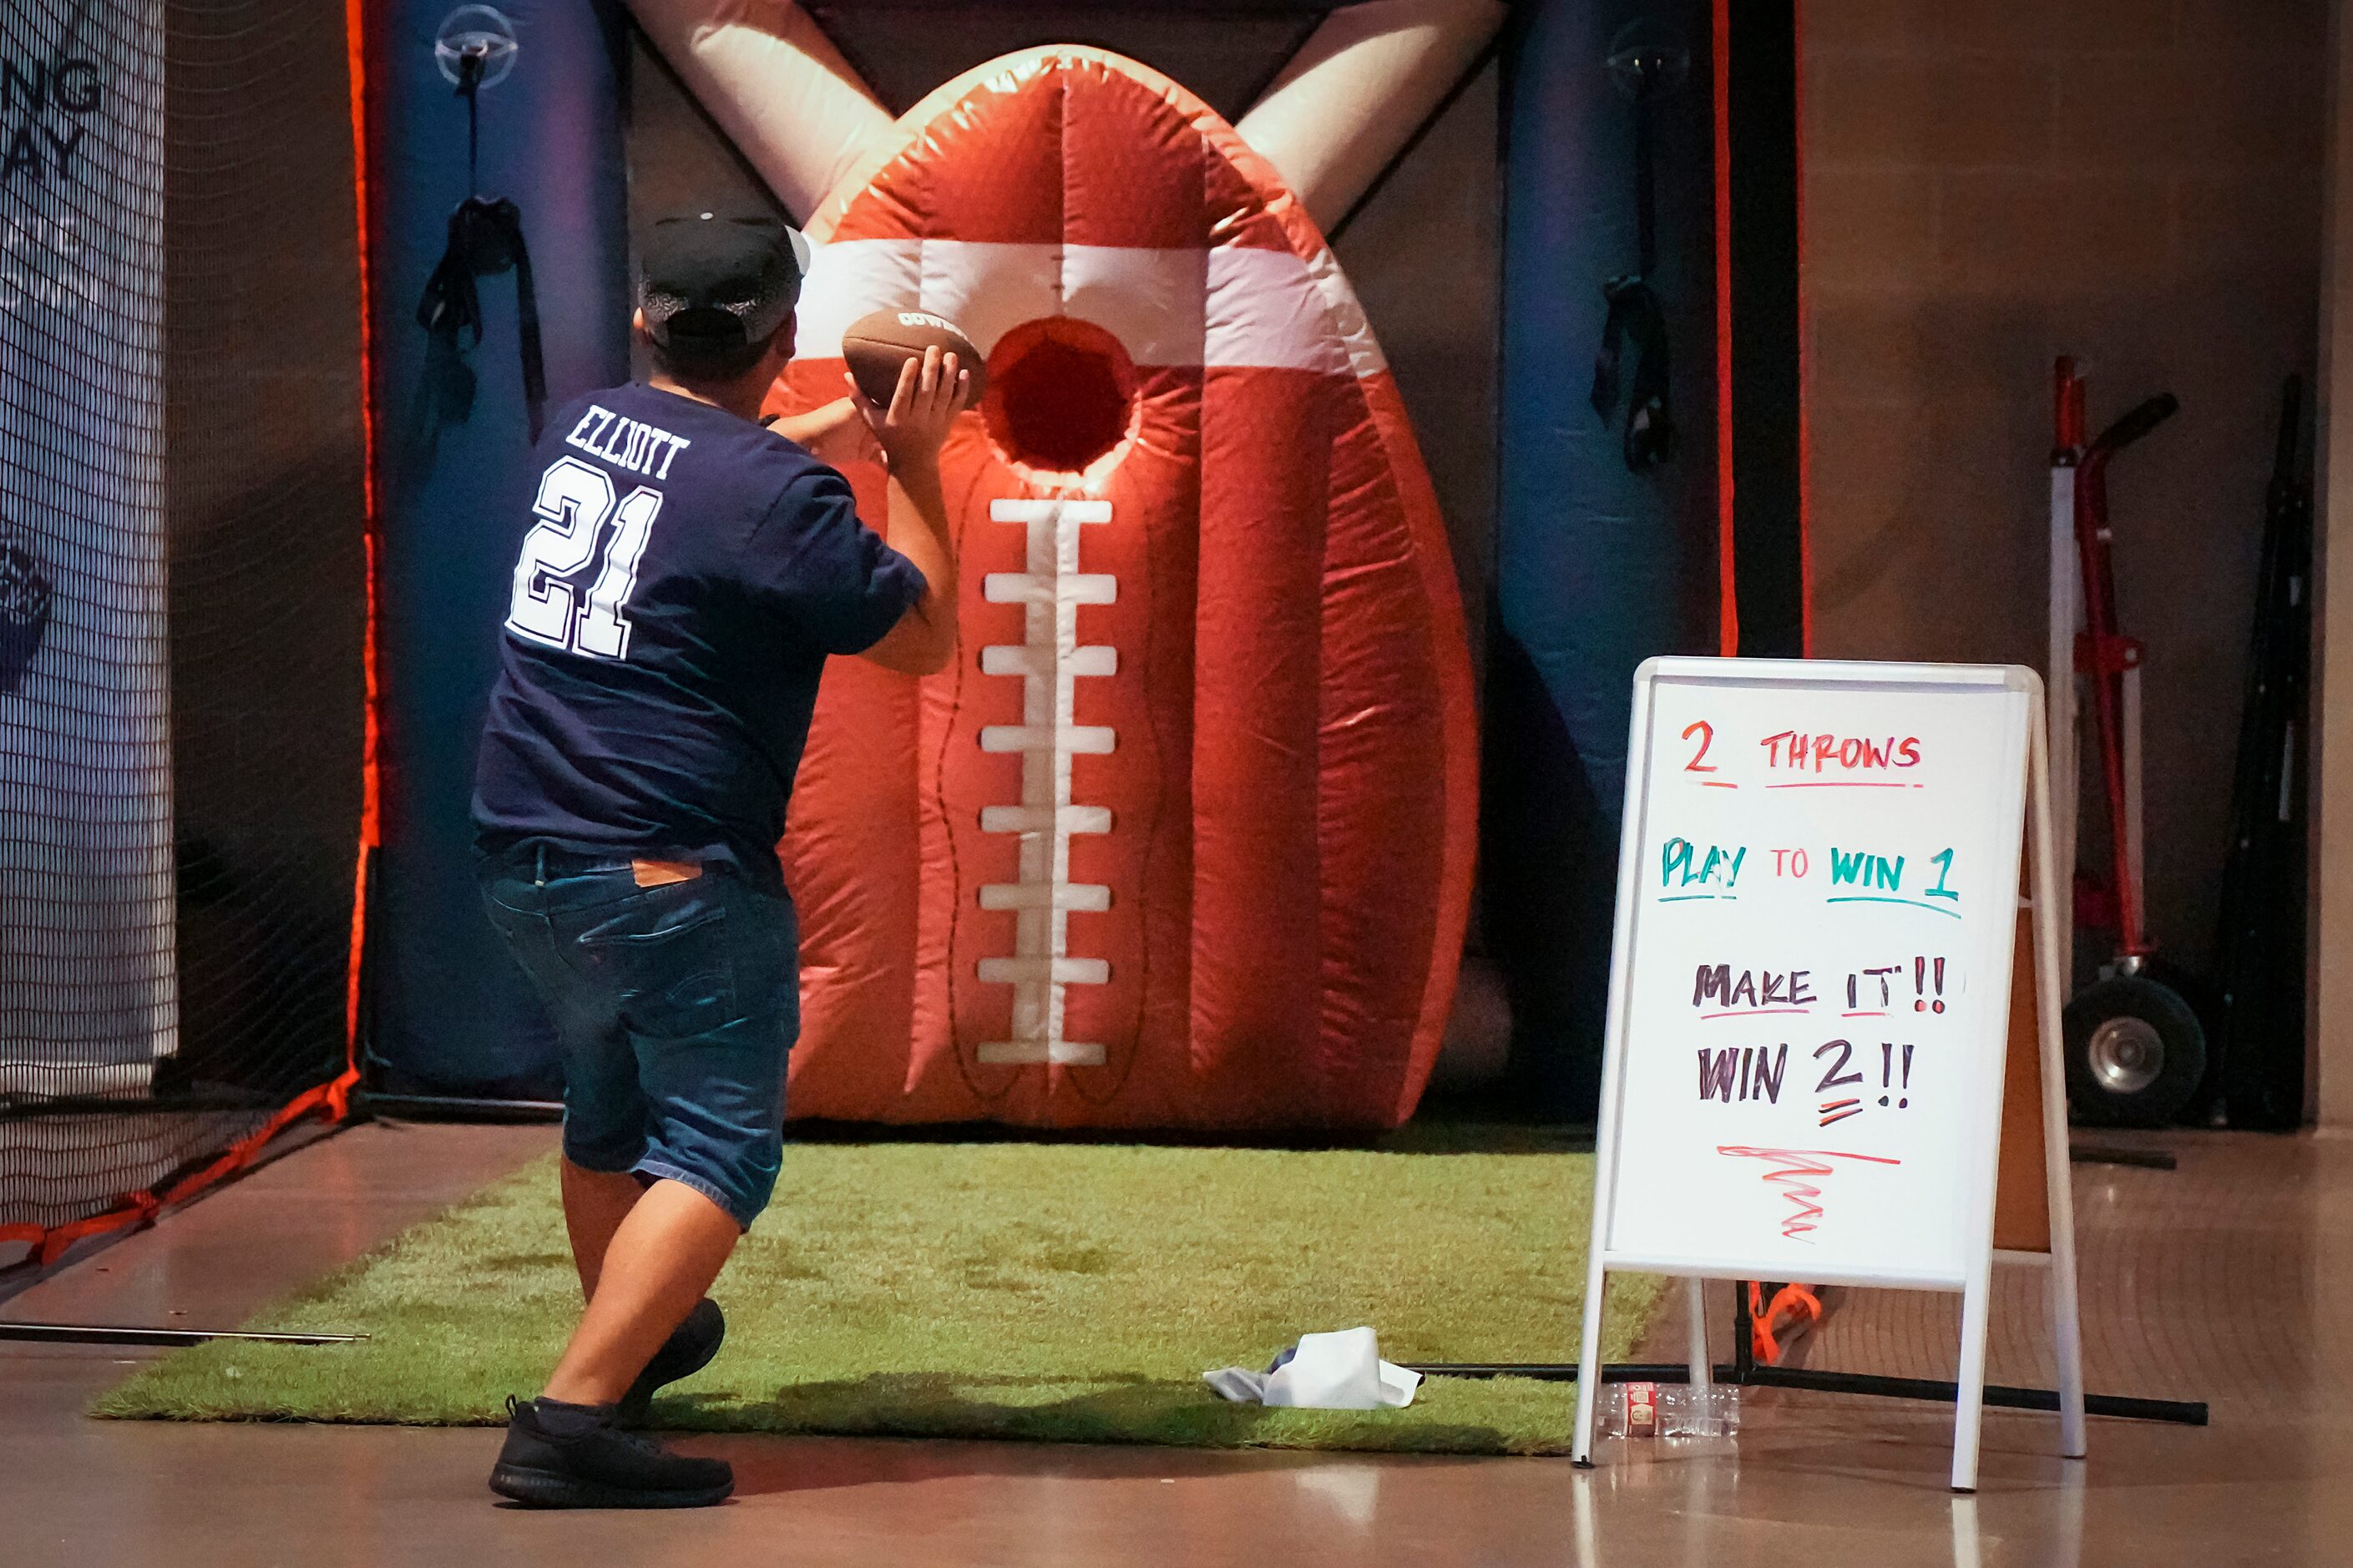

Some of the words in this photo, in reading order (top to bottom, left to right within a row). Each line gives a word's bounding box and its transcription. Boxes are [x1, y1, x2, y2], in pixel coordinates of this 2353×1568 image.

[565, 404, 691, 481] ELLIOTT
[504, 454, 664, 661] 21
[1681, 720, 1718, 773] 2
[1760, 730, 1922, 773] THROWS
[1662, 837, 1746, 888] PLAY
[1771, 848, 1809, 879] TO
[1830, 847, 1905, 893] WIN
[1924, 847, 1960, 900] 1
[1692, 964, 1818, 1007] MAKE
[1698, 1044, 1789, 1104] WIN
